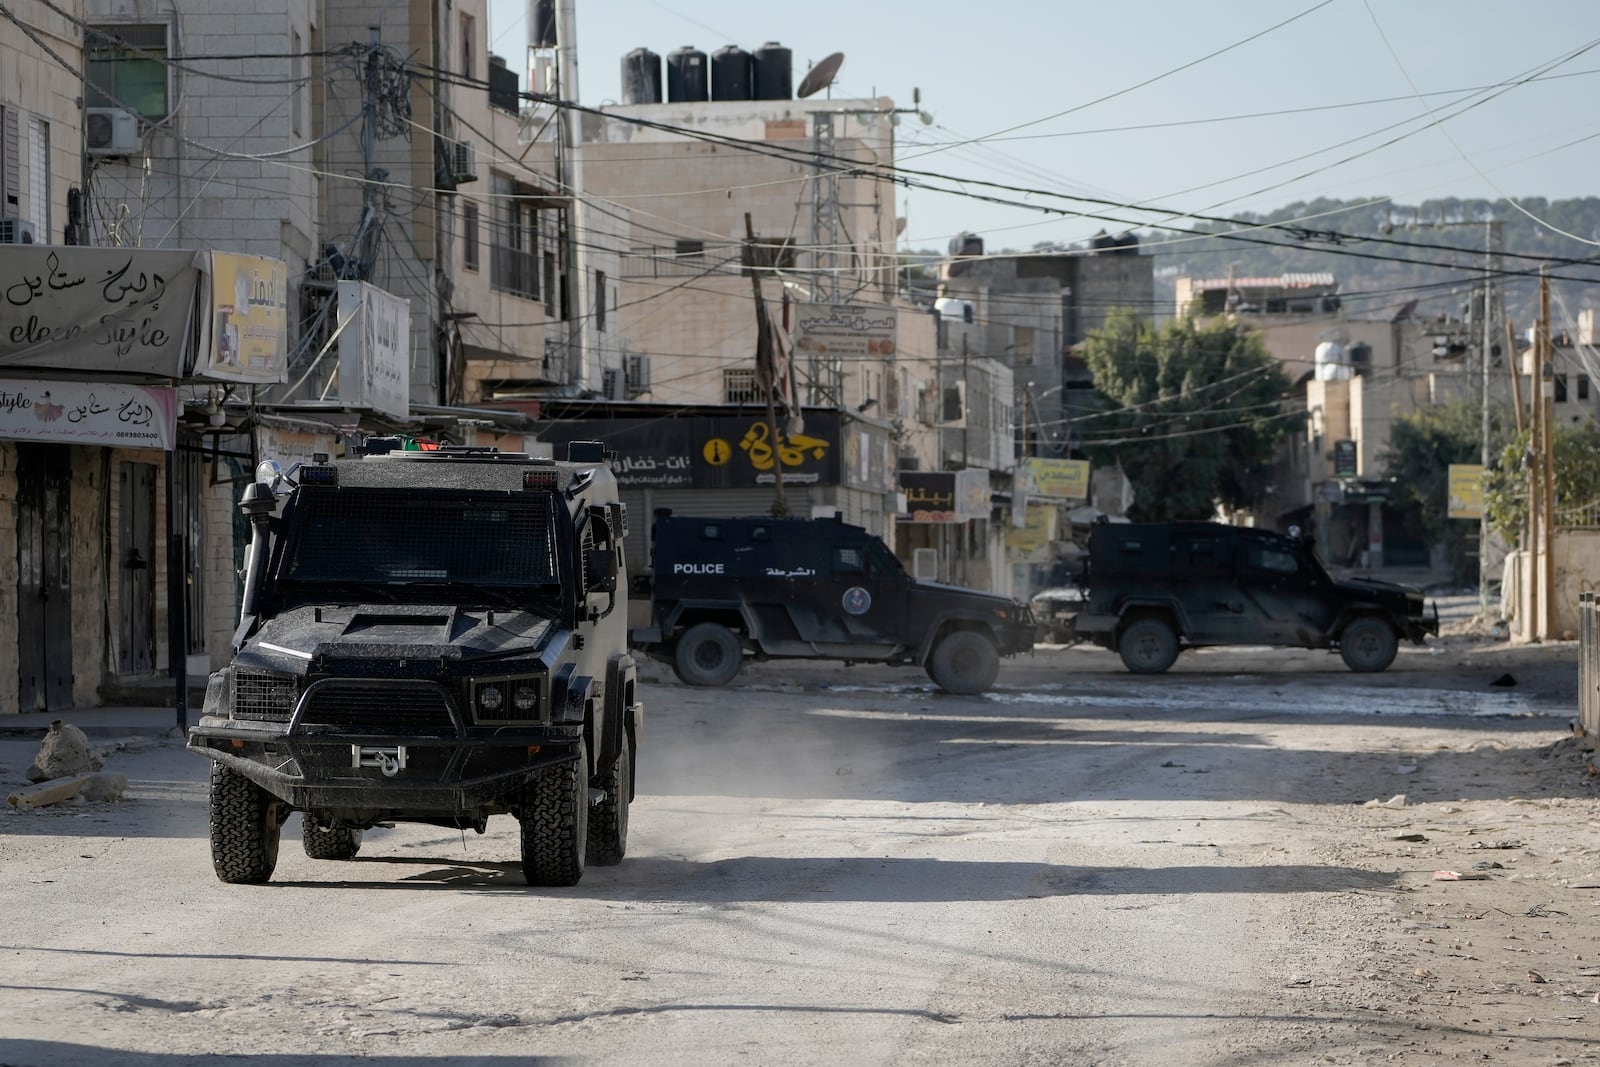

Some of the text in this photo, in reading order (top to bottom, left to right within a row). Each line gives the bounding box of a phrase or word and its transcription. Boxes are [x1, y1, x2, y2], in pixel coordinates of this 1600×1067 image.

[7, 251, 86, 305] ستايل
[68, 393, 110, 423] ستايل
[673, 563, 725, 574] POLICE
[765, 567, 817, 577] الشرطة
